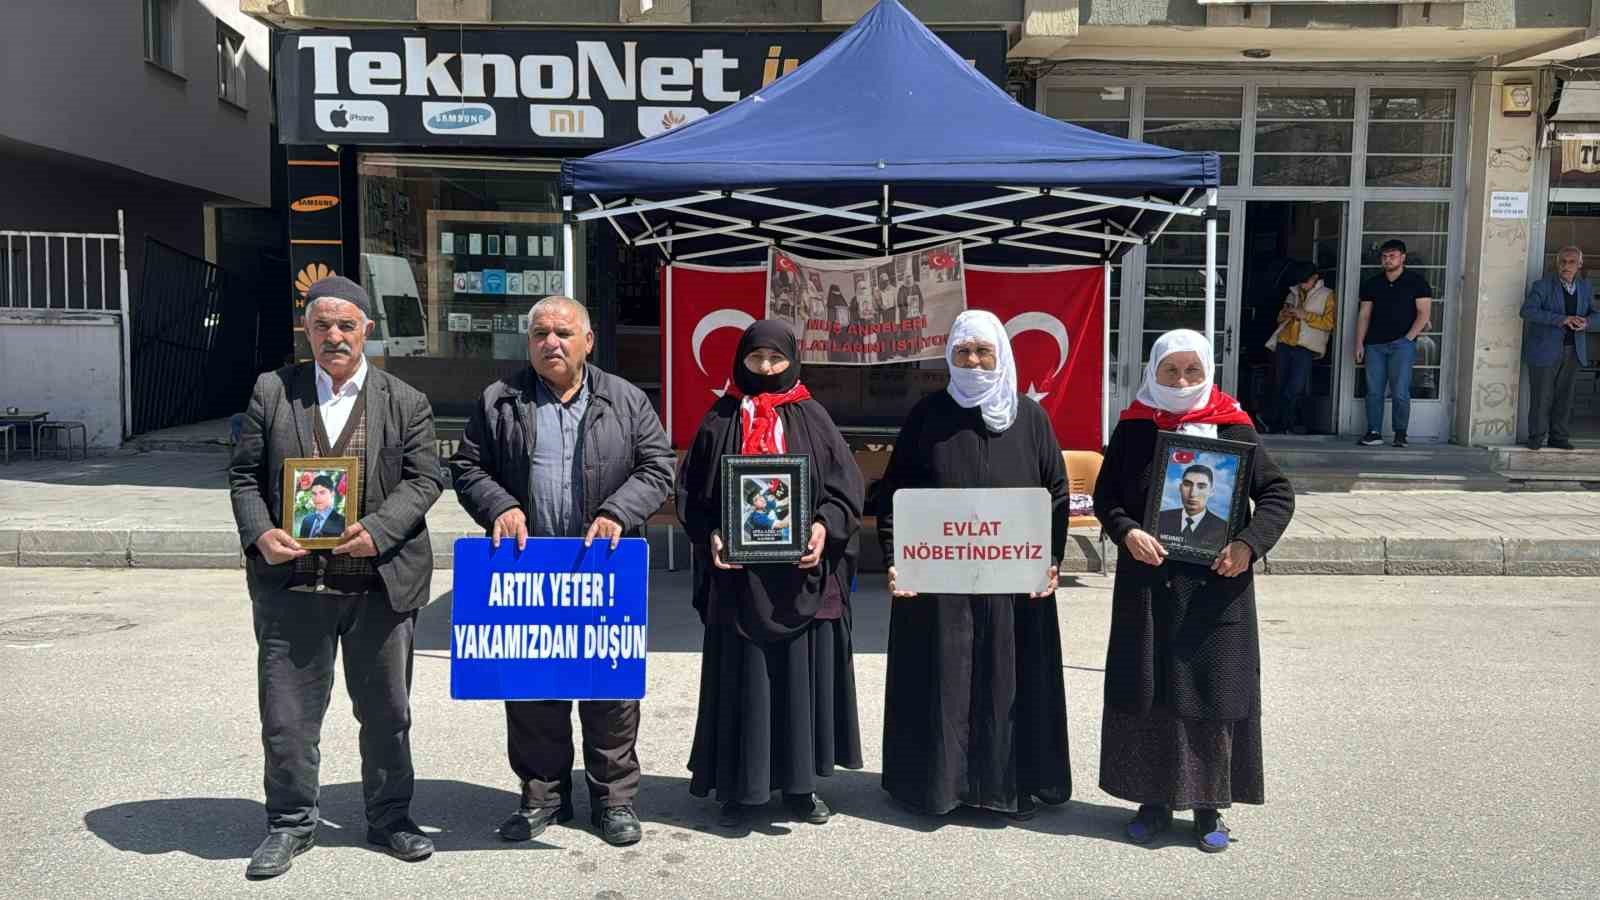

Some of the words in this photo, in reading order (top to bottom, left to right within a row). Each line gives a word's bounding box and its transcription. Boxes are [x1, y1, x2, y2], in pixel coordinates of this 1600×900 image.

[298, 36, 740, 101] TeknoNet
[349, 112, 375, 122] iPhone
[434, 112, 485, 124] SAMSUNG
[806, 319, 841, 336] MUŞ
[943, 522, 1002, 536] EVLAT
[903, 542, 1043, 560] NÖBETİNDEYİZ
[488, 572, 545, 607] ARTIK
[549, 572, 604, 607] YETER
[609, 573, 615, 607] !
[454, 624, 579, 659] YAKAMIZDAN
[583, 615, 646, 669] DÜŞÜN
